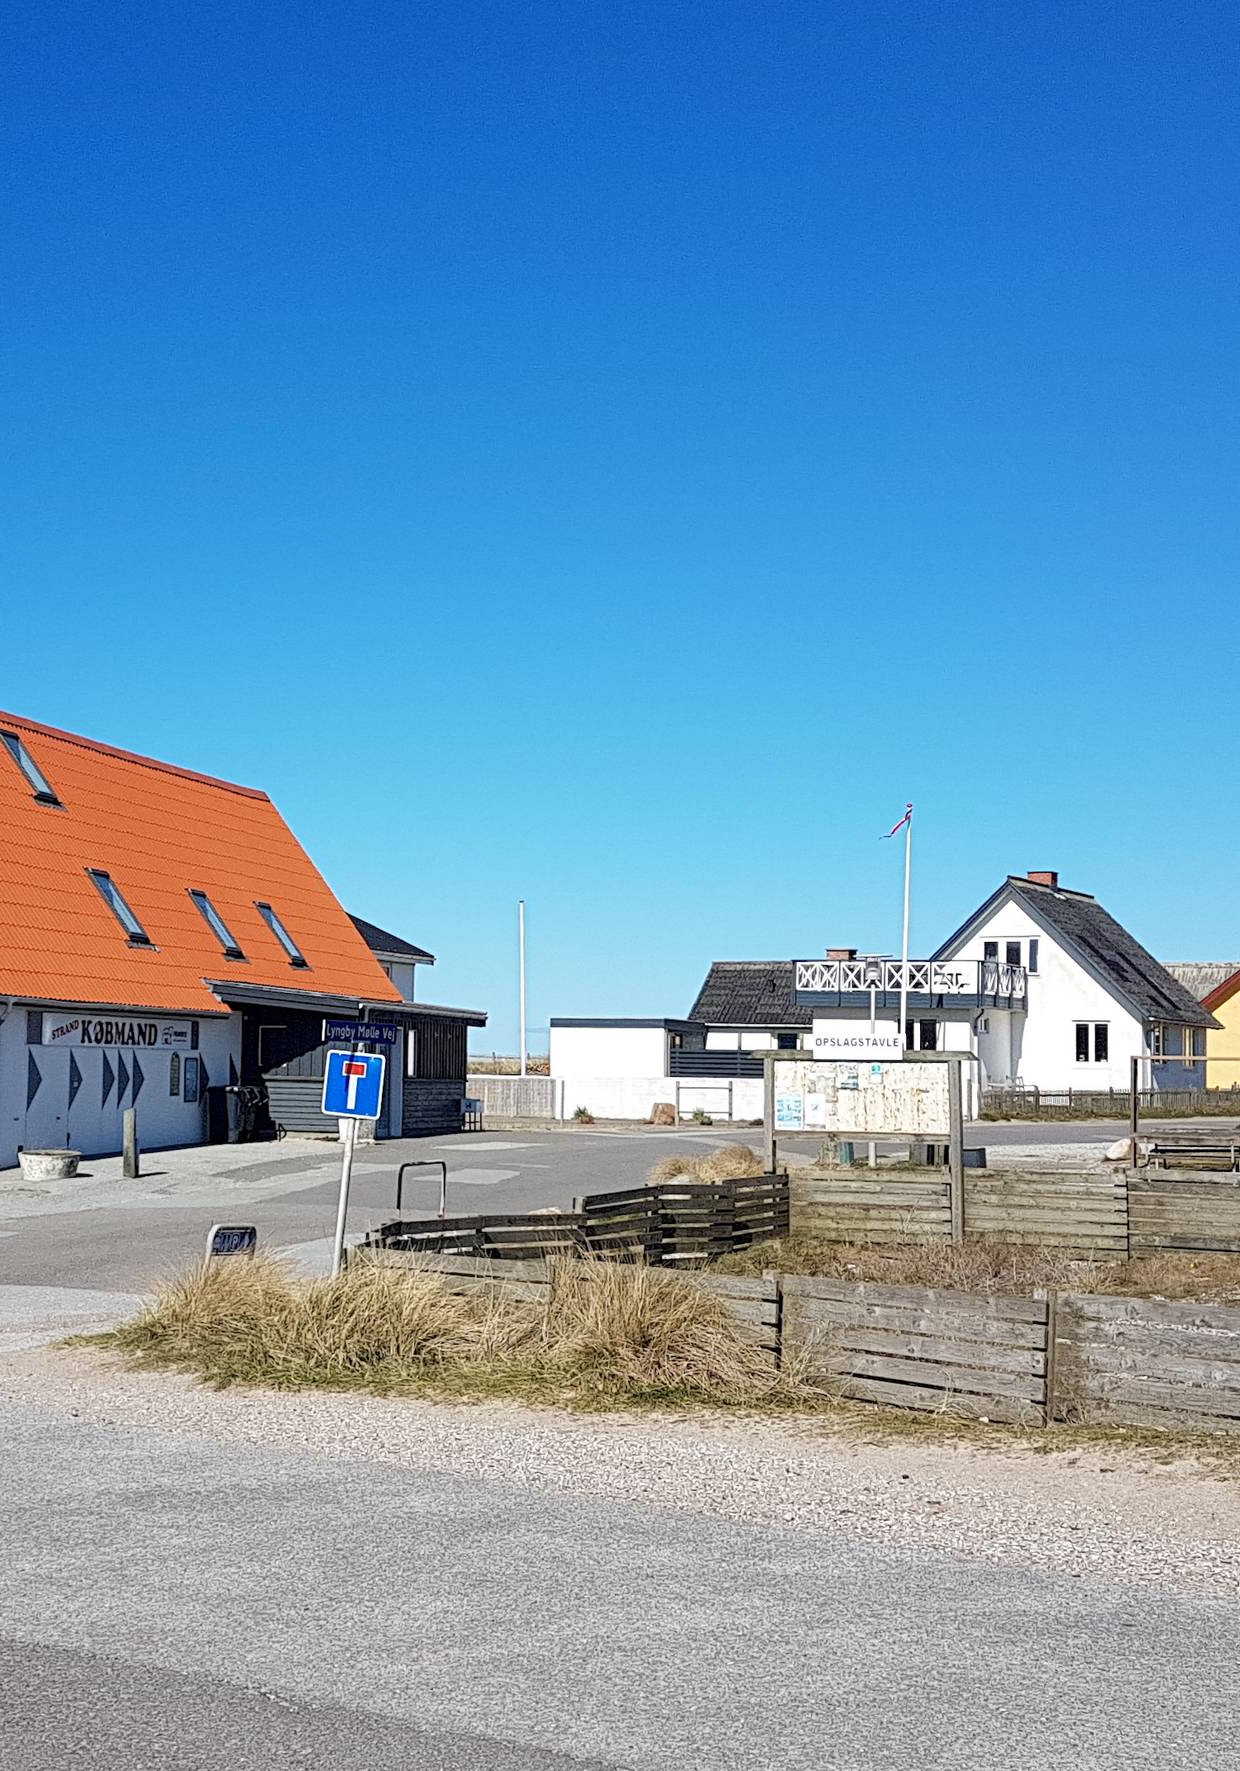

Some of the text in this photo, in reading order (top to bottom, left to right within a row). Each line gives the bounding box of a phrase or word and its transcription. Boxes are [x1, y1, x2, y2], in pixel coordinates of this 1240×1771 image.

[52, 1019, 80, 1040] STRAND
[80, 1019, 158, 1046] KØBMAND
[326, 1023, 396, 1042] Lyngby Mølle Vej
[815, 1037, 900, 1047] OPSLAGSTAVLE
